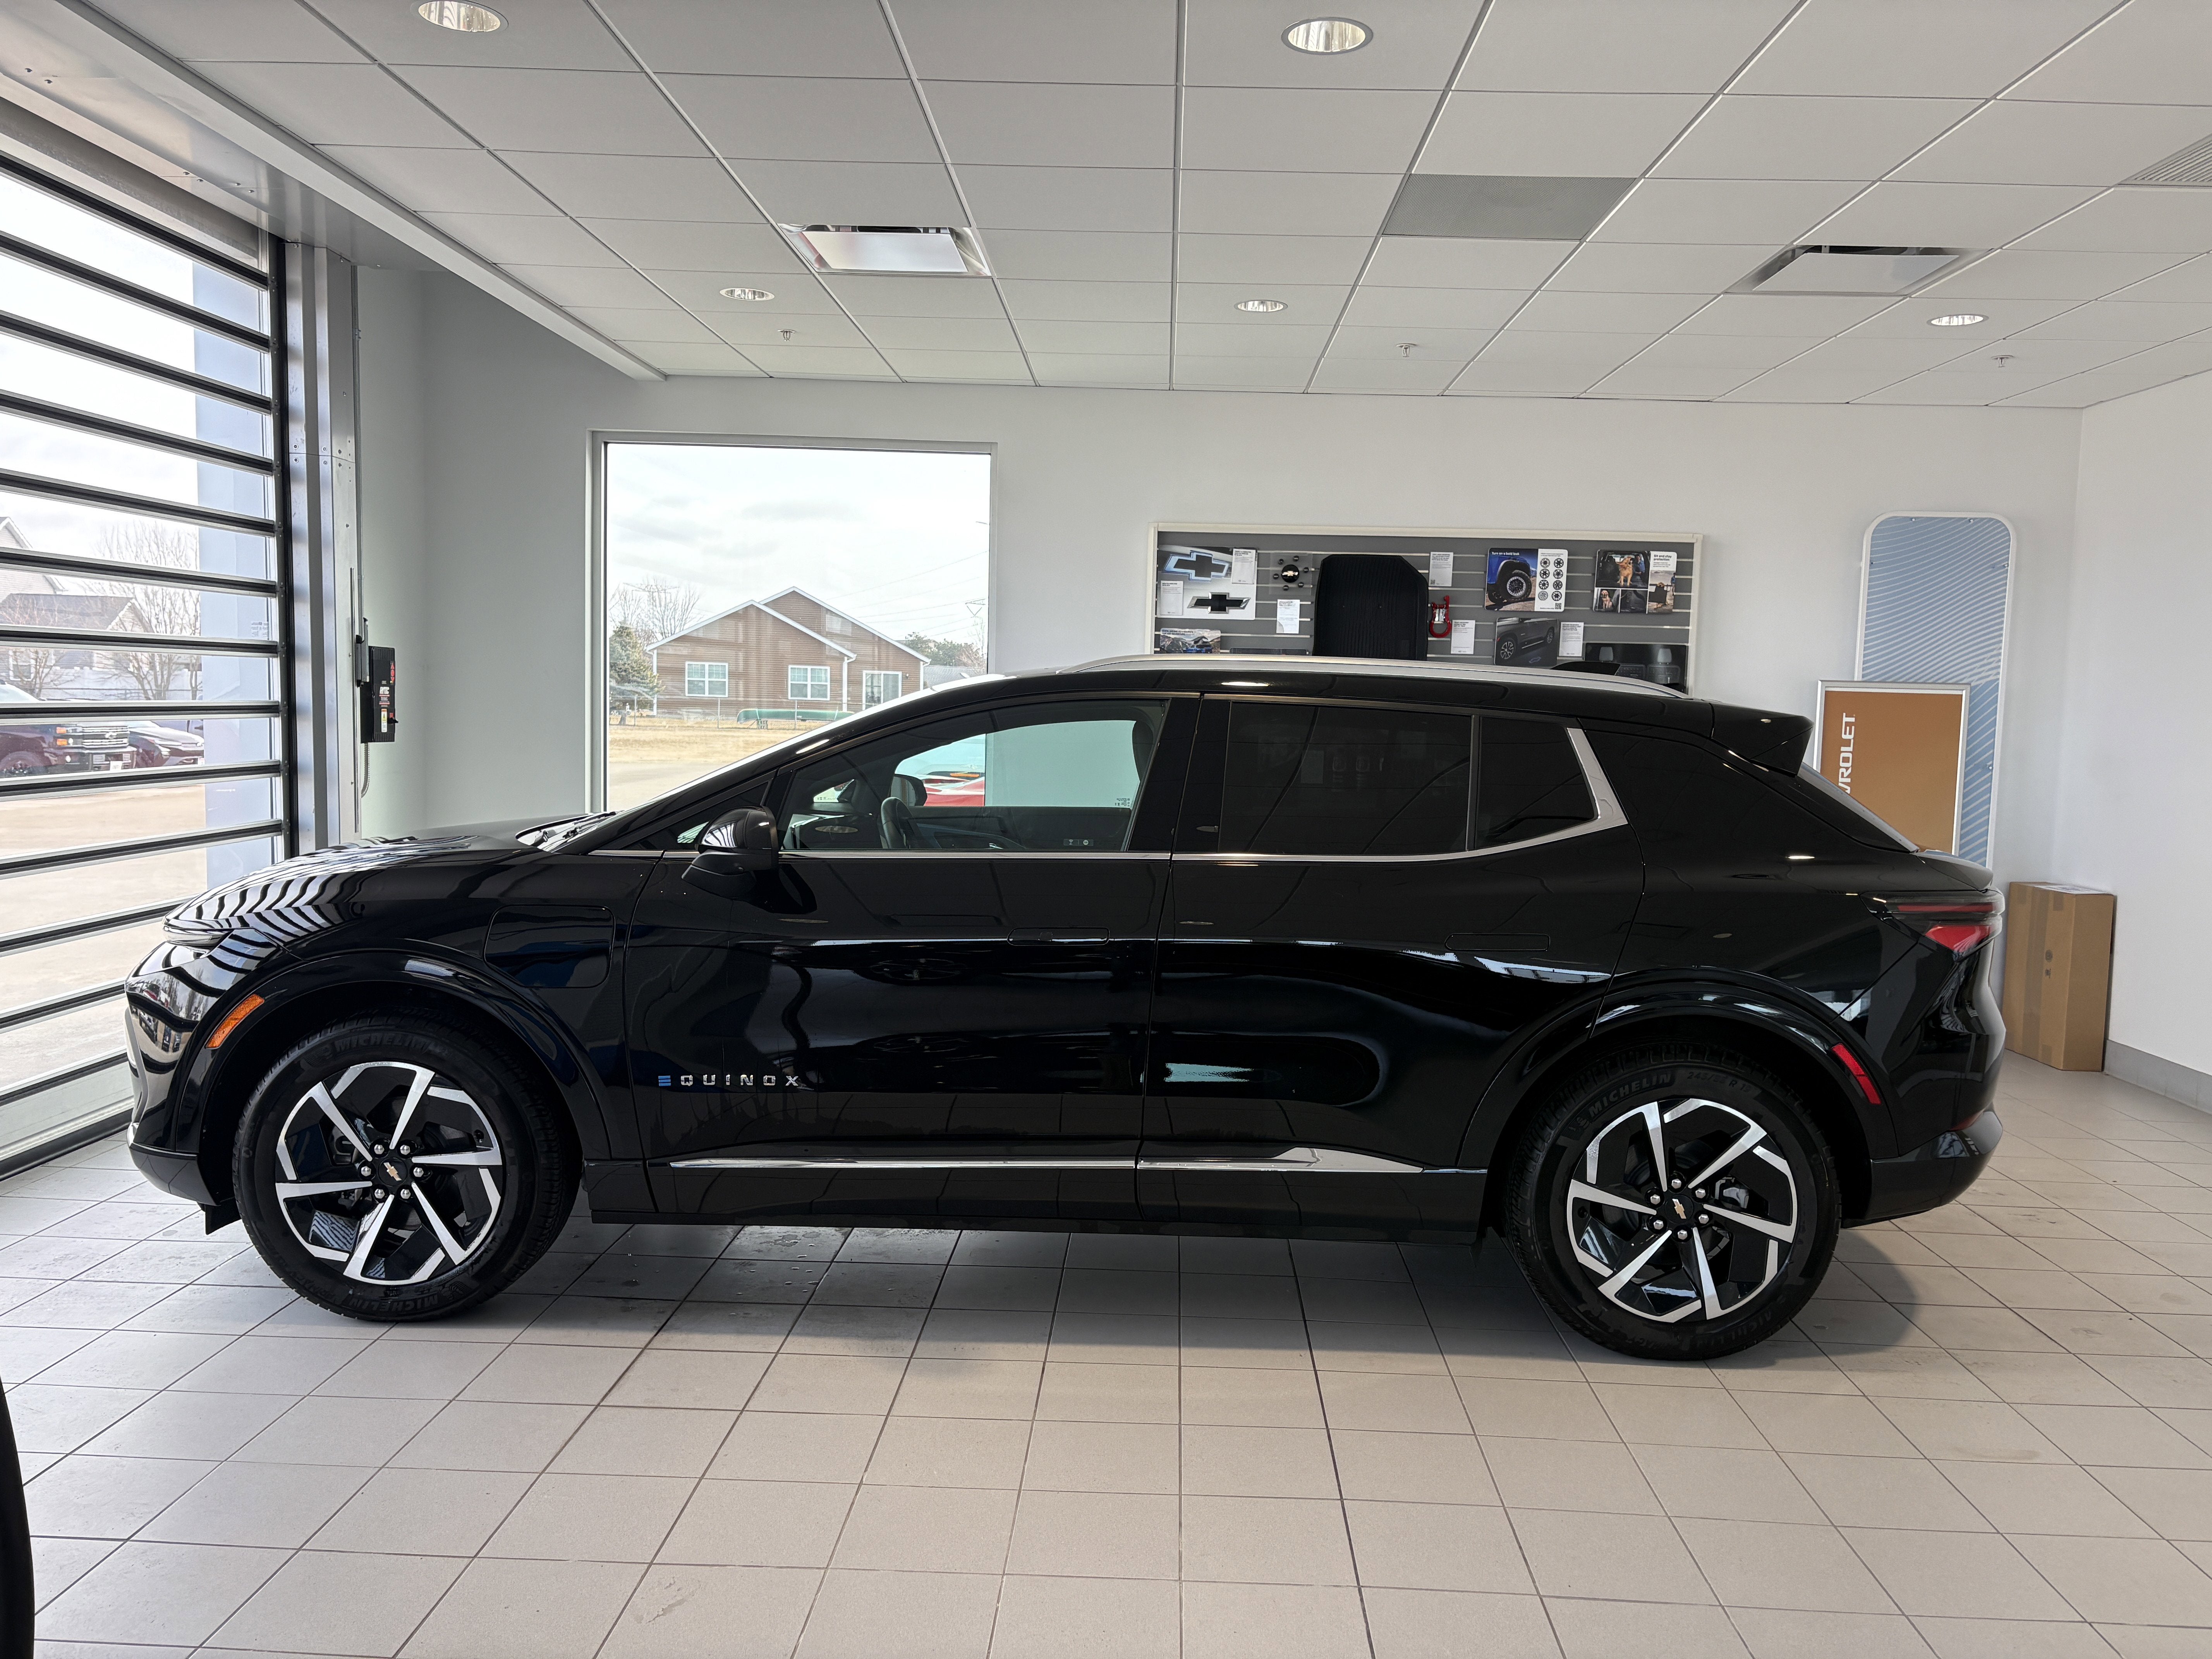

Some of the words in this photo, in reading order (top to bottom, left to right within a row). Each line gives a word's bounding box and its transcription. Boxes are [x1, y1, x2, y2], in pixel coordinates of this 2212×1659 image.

[335, 1034, 431, 1053] MICHELIN
[658, 1075, 799, 1086] EQUINOX
[1589, 1073, 1672, 1117] MICHELIN
[347, 1294, 438, 1312] MICHELIN
